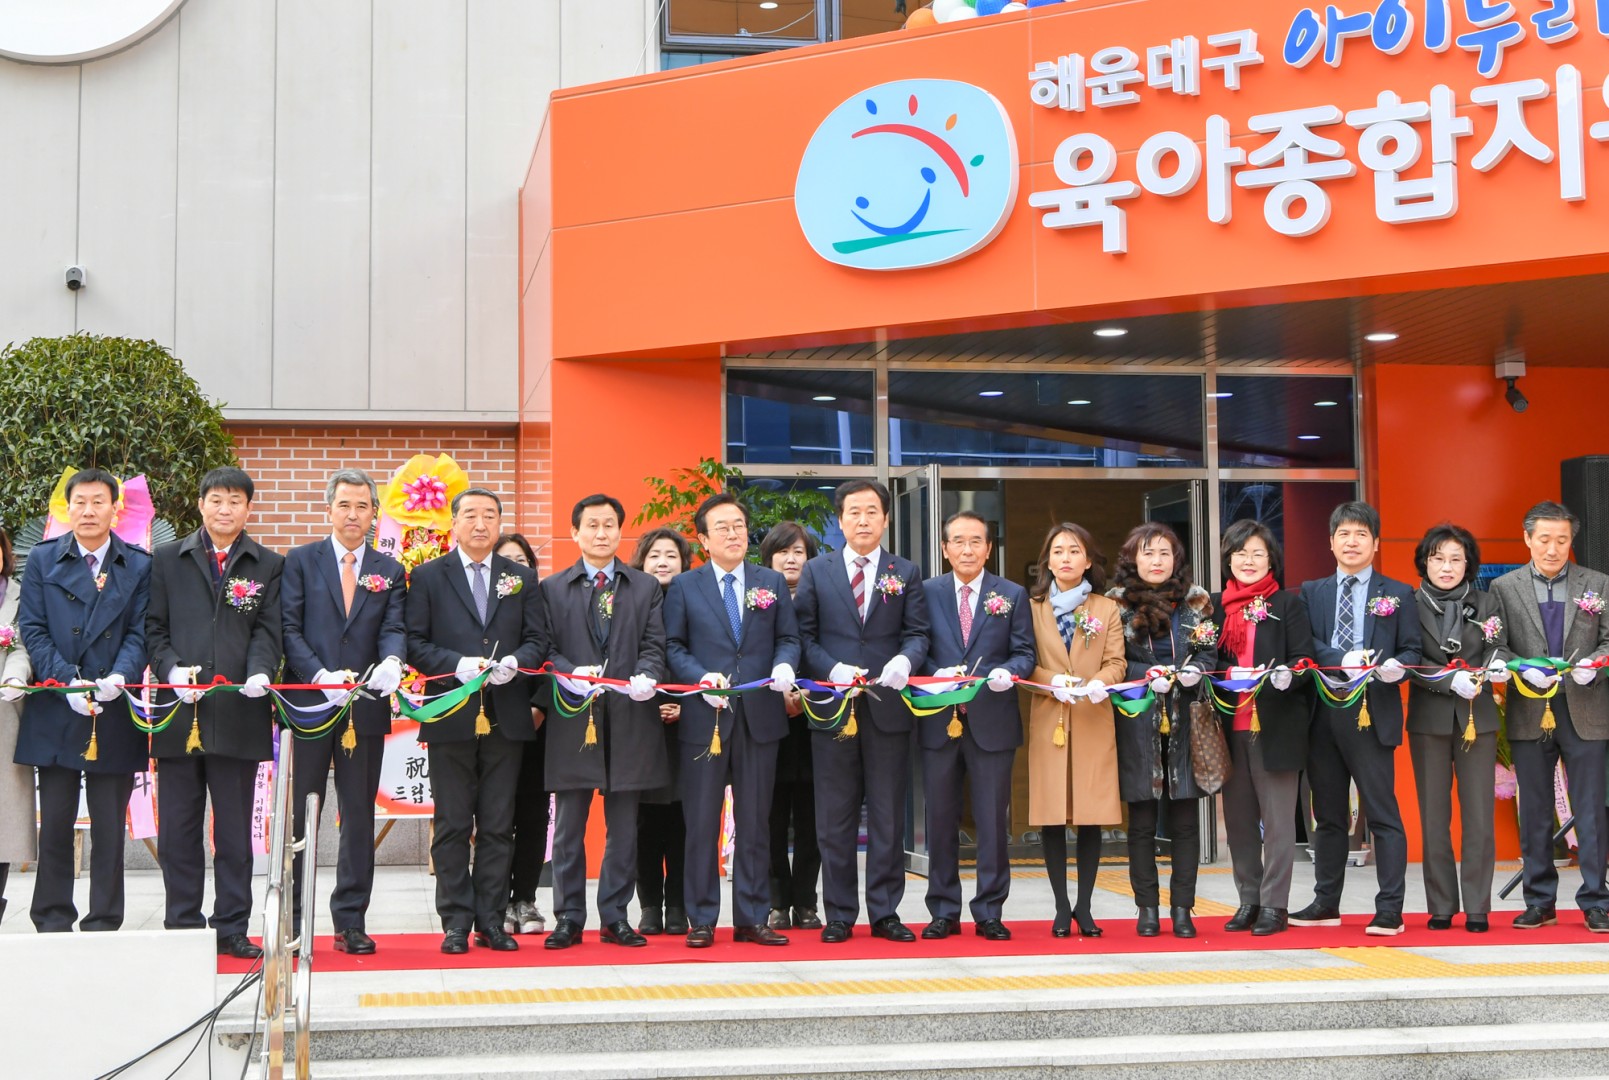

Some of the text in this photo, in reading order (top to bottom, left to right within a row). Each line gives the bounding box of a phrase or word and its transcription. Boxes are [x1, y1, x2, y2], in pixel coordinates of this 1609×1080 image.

[1028, 28, 1264, 113] 해운대구
[1028, 64, 1609, 255] 육아종합지
[405, 756, 429, 779] 祝
